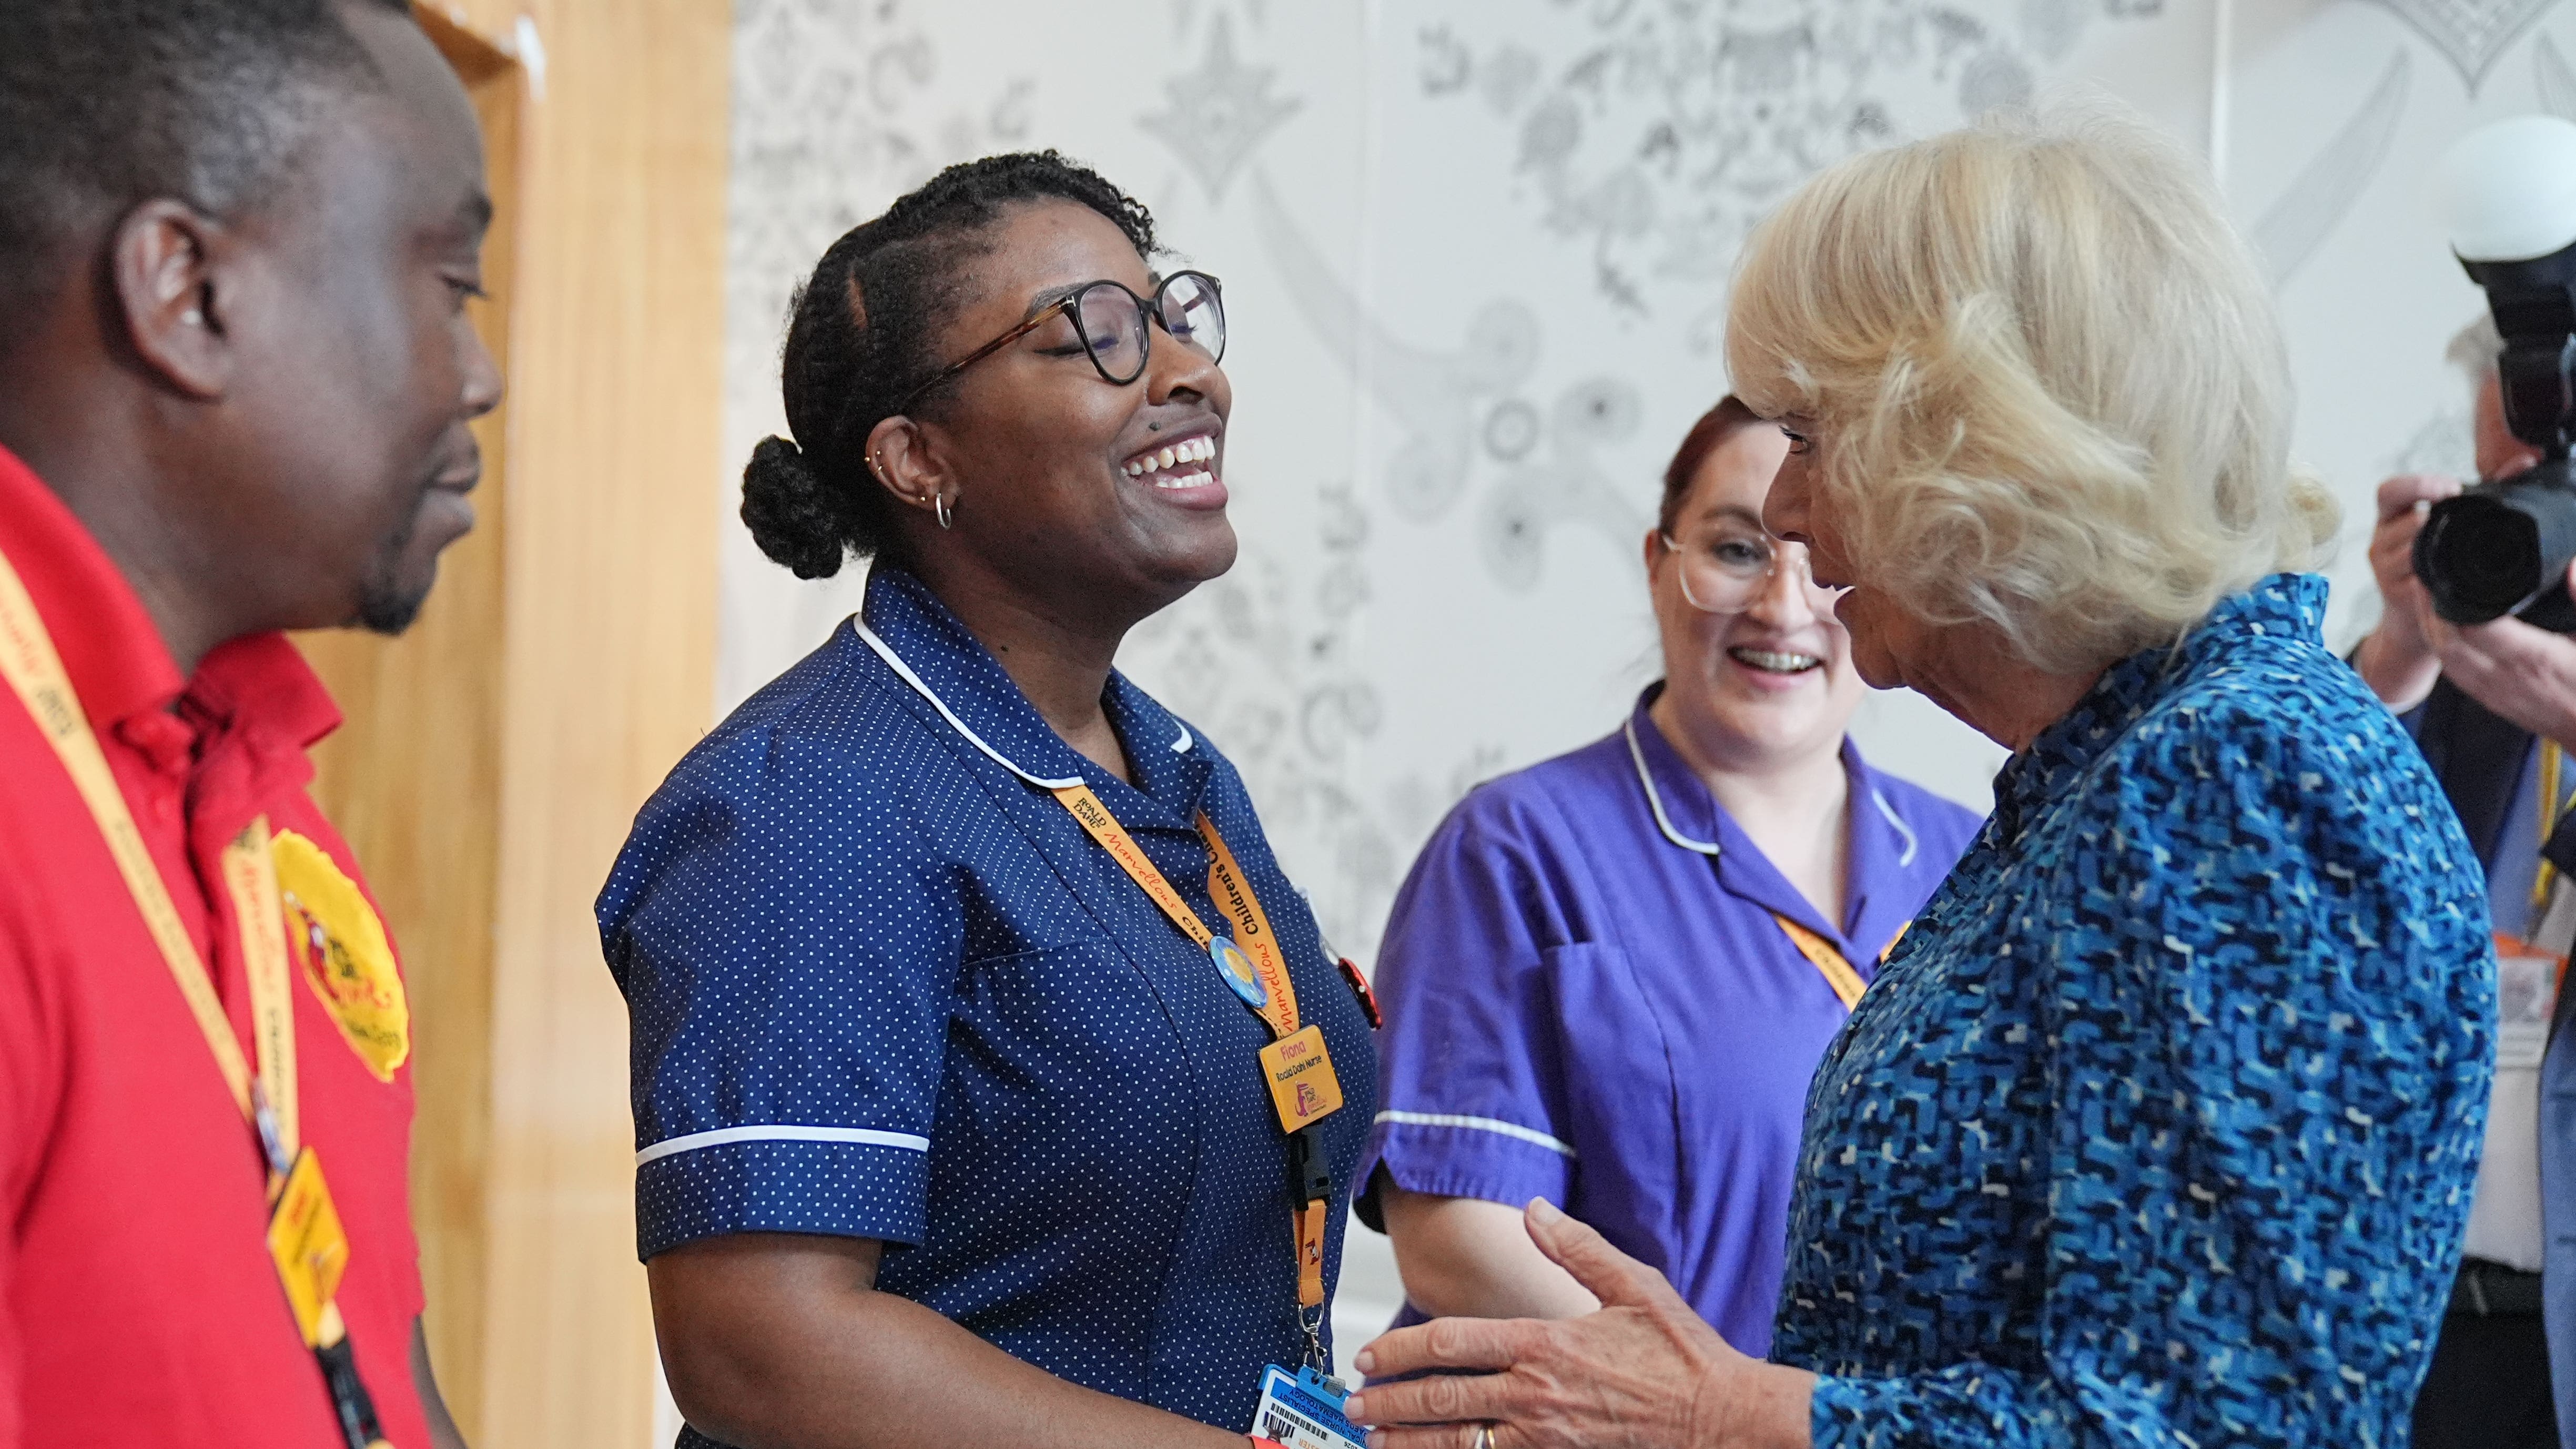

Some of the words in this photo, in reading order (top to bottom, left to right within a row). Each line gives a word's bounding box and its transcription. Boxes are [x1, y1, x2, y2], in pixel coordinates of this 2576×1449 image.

[1104, 833, 1178, 909] Marvellous
[1215, 863, 1259, 935] Children's
[1254, 943, 1293, 1032] Marvellous
[1280, 1041, 1306, 1061] Fiona
[1276, 1068, 1294, 1082] Roald
[1293, 1061, 1307, 1075] Dahl
[1306, 1055, 1322, 1069] Nurse
[1279, 1393, 1320, 1420] SPECIALIST
[1289, 1389, 1343, 1422] HAEMATOLOGY
[1320, 1419, 1345, 1435] NURSE
